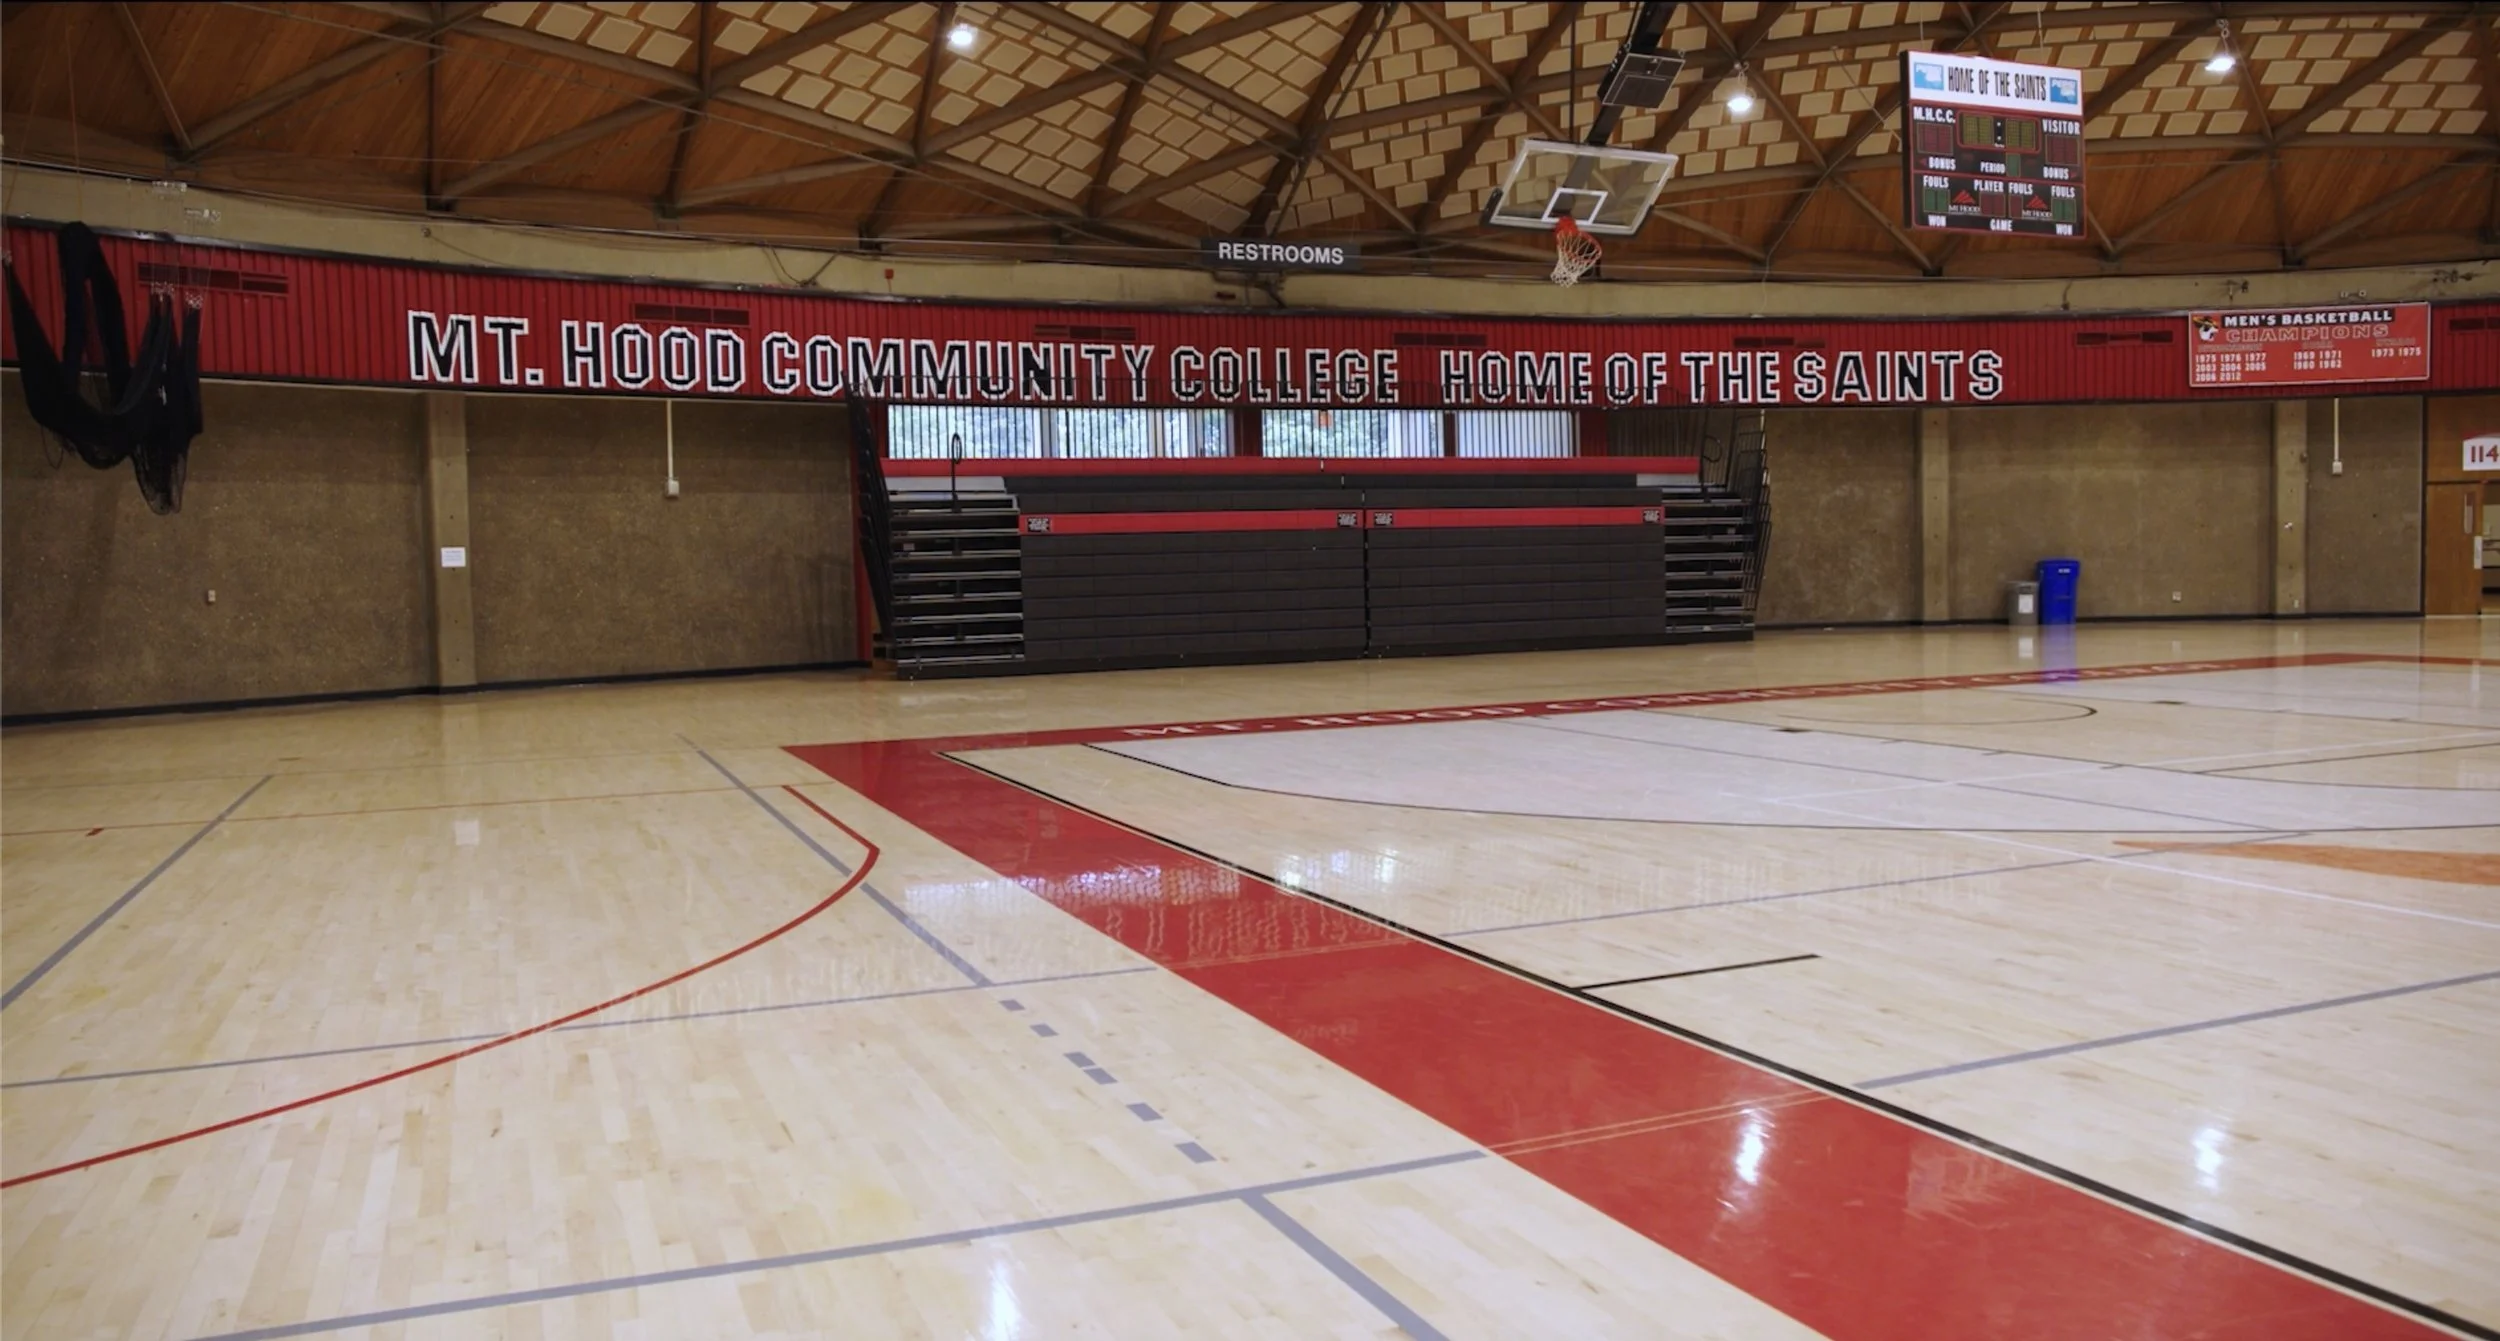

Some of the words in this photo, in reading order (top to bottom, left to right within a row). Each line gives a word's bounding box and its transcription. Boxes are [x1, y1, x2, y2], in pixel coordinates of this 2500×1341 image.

[1948, 66, 1974, 93] HOME
[1978, 69, 1990, 95] OF
[1994, 71, 2010, 97] THE
[2015, 73, 2047, 101] SAINTS
[1913, 106, 1956, 123] M.H.C.C.
[2042, 119, 2080, 135] VISITOR
[1929, 157, 1956, 170] BONUS
[1980, 161, 2006, 174] PERIOD
[2043, 166, 2069, 180] BONUS
[1923, 175, 1949, 188] FOULS
[1974, 179, 2004, 192] PLAYER
[2008, 182, 2033, 196] FOULS
[2051, 185, 2076, 198] FOULS
[1928, 214, 1947, 227] WON
[1990, 218, 2013, 232] GAME
[2056, 223, 2073, 236] WON
[1218, 242, 1344, 265] RESTROOMS
[2225, 315, 2276, 327] MEN'S
[2282, 310, 2392, 325] BASKETBALL
[2227, 324, 2389, 342] CHAMPIONS
[407, 309, 544, 386] MT.
[561, 320, 745, 392] HOOD
[762, 331, 1154, 402] COMMUNITY
[1170, 345, 1399, 404] COLLEGE
[2320, 350, 2342, 359] 1971
[2371, 348, 2394, 358] 1973
[2398, 346, 2421, 356] 1975
[1440, 350, 1592, 404] HOME
[1605, 351, 1667, 404] OF
[1681, 351, 1780, 404] THE
[1793, 350, 2003, 402] SAINTS
[2470, 445, 2500, 463] 114
[1295, 706, 1524, 726] HOOD
